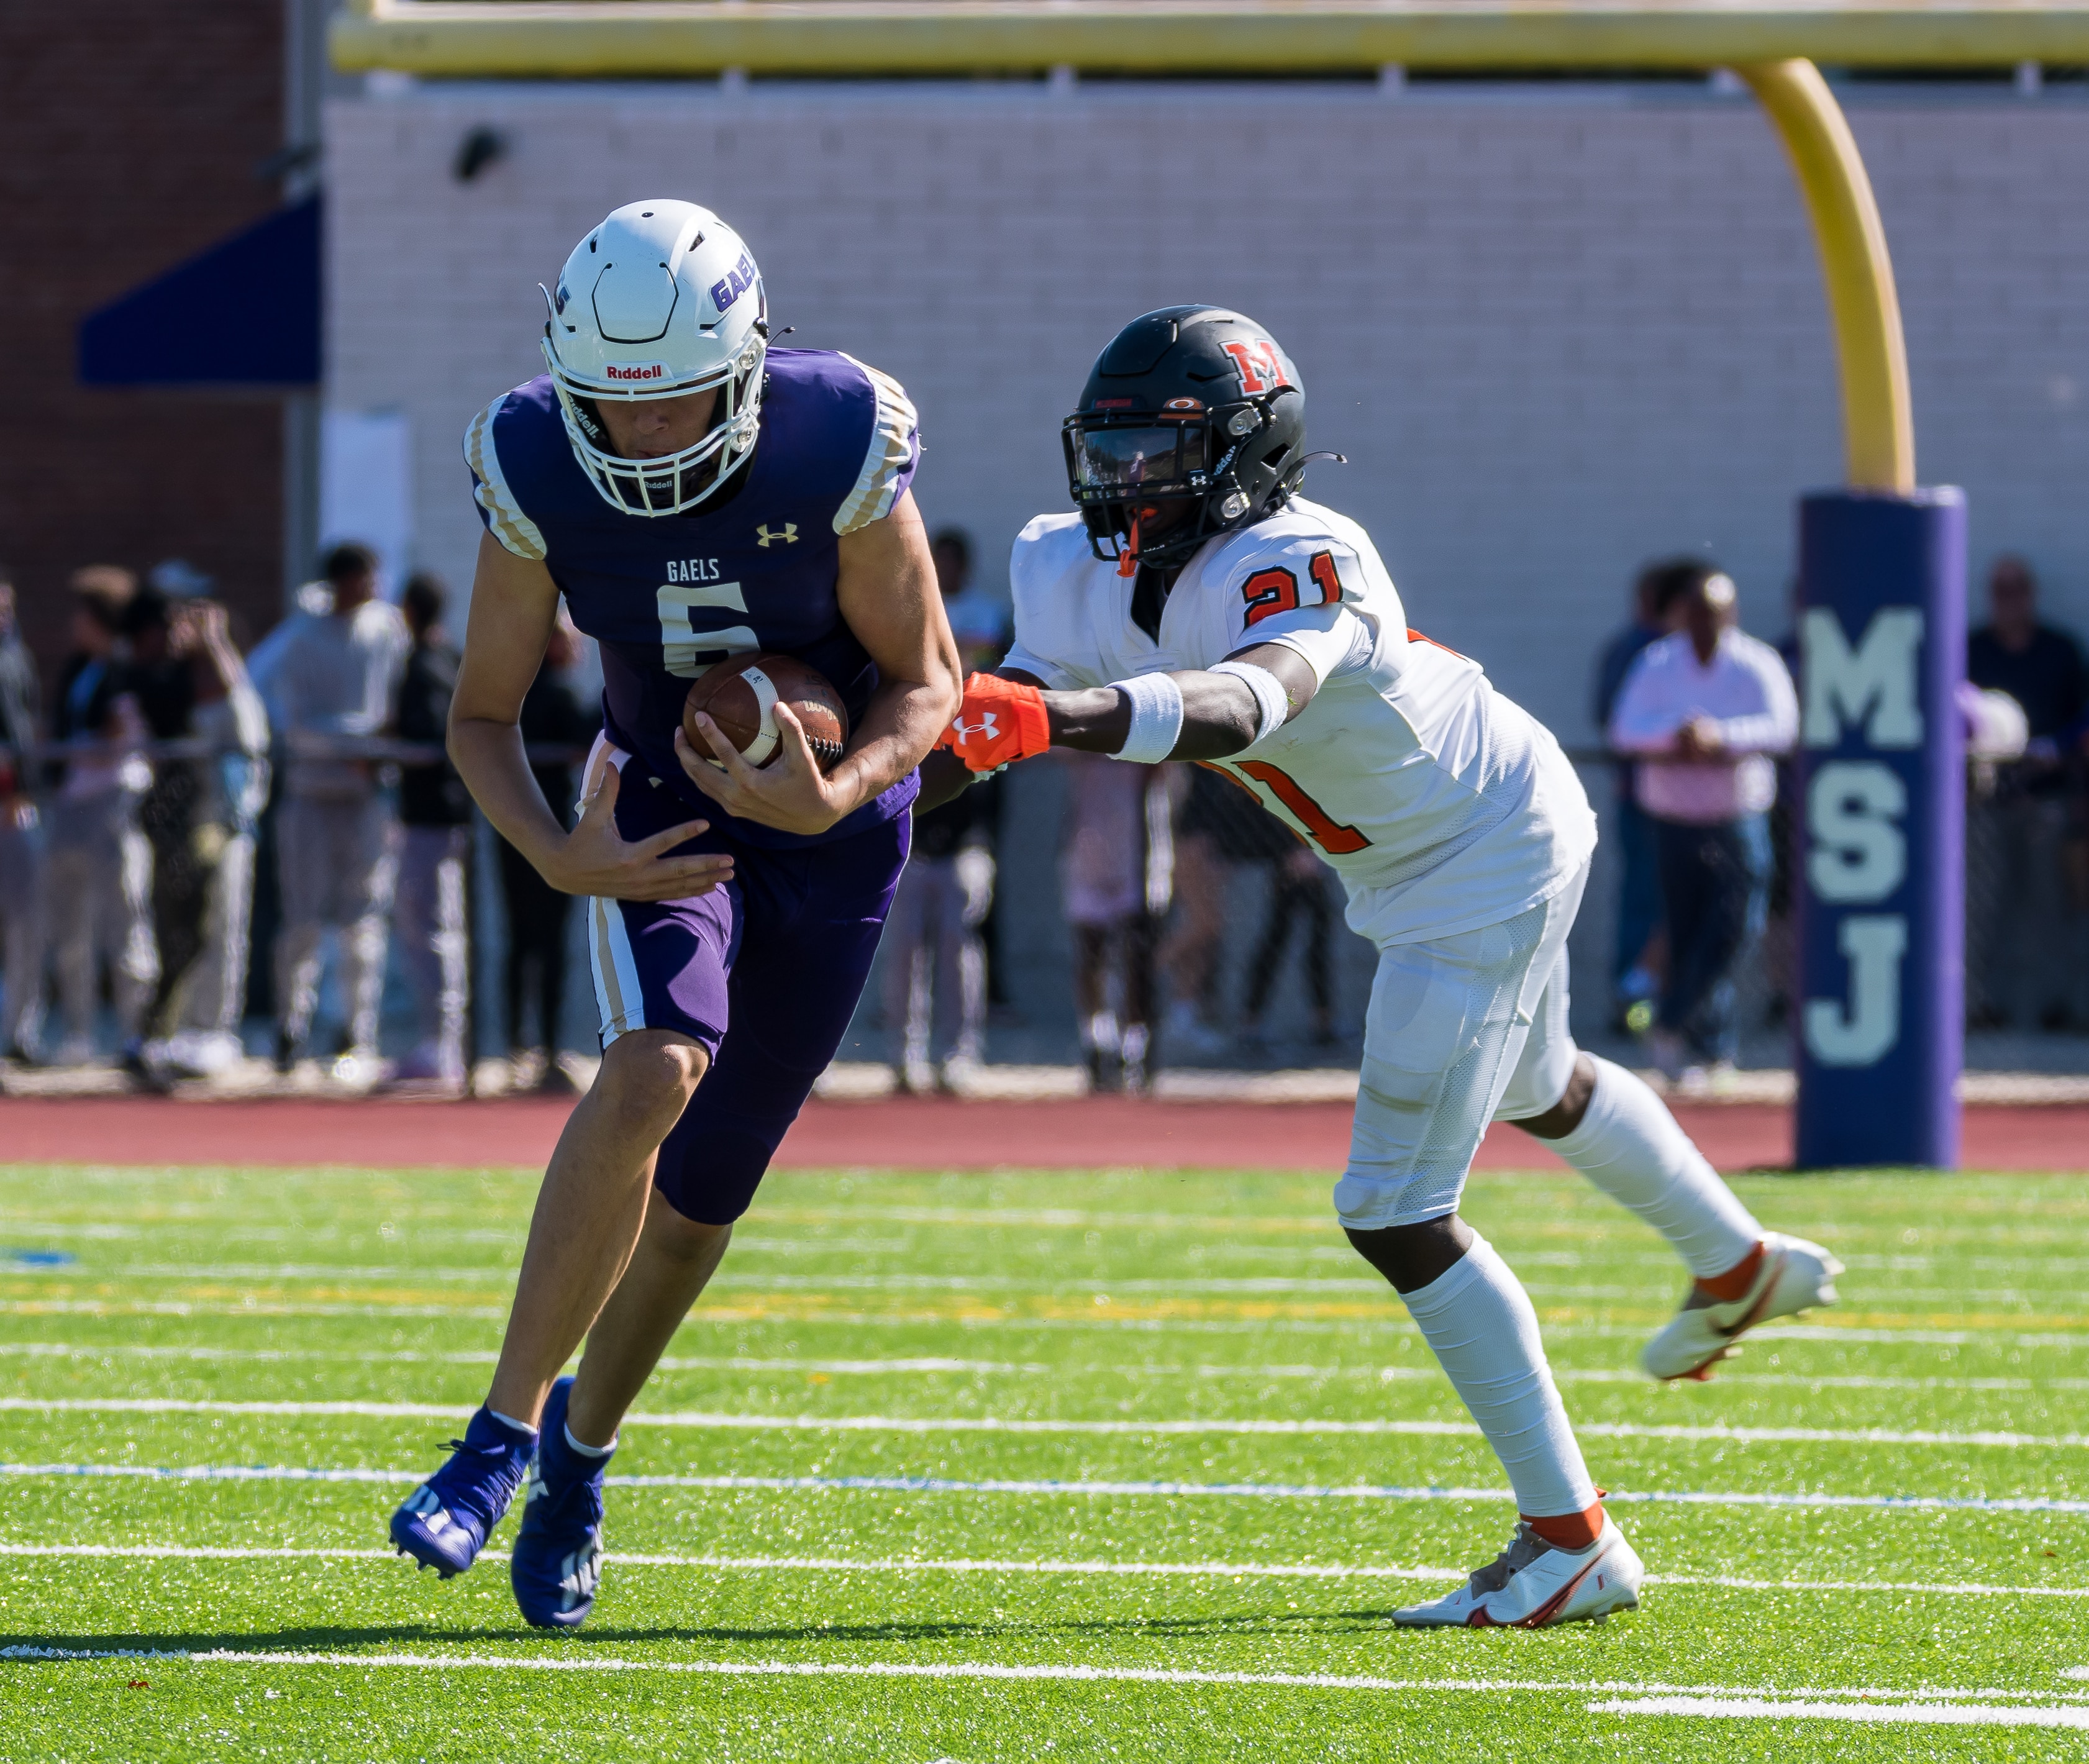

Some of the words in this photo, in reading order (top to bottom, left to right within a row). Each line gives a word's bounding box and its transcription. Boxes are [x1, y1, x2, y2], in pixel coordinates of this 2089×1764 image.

[710, 253, 755, 313] GAEL
[606, 365, 662, 380] Riddell
[1219, 339, 1290, 396] M
[667, 558, 720, 582] GAELS
[1242, 549, 1344, 631] 21
[657, 581, 761, 678] 6
[1193, 759, 1375, 855] 1
